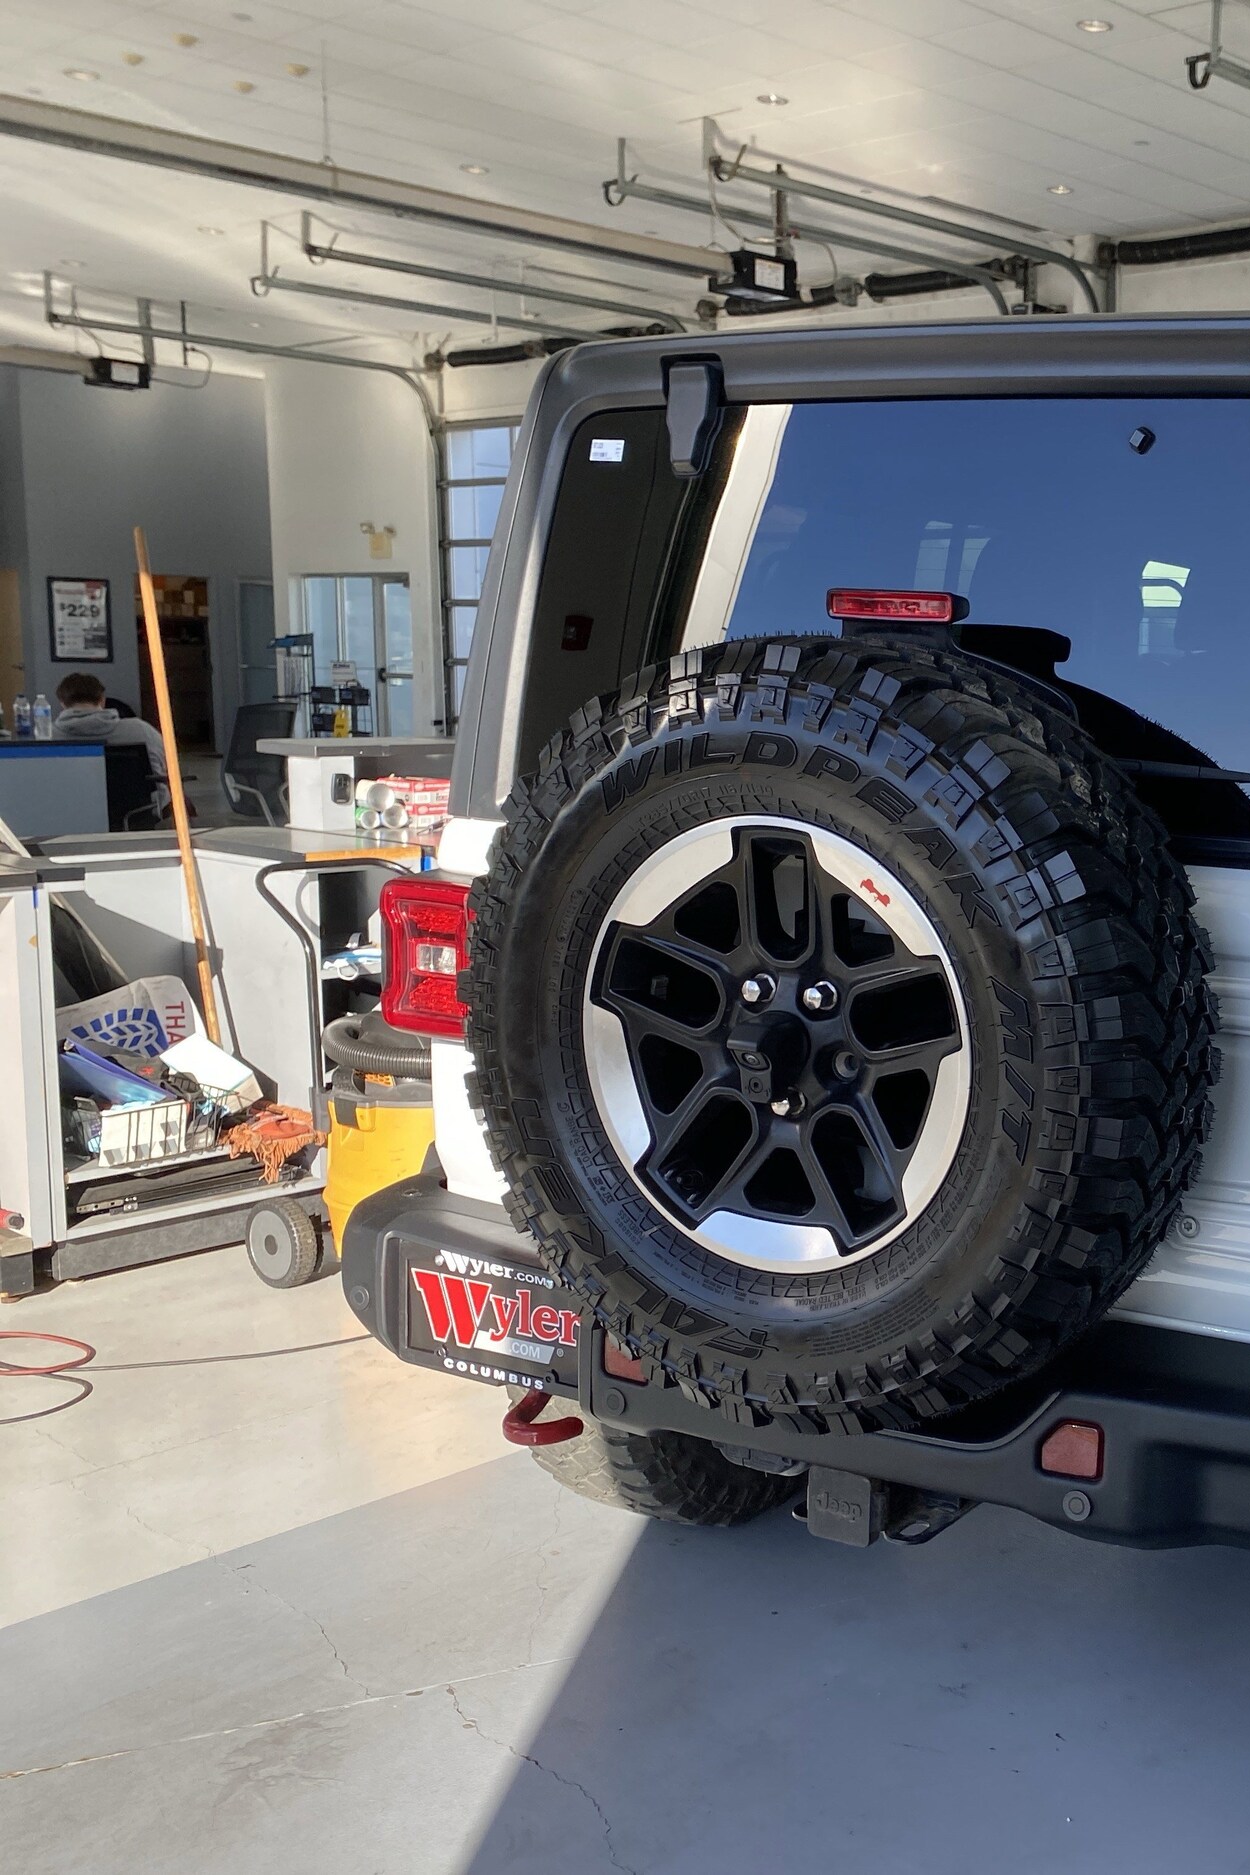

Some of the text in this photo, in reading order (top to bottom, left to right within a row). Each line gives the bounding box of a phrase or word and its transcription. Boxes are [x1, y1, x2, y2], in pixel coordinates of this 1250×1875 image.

[598, 730, 1035, 1167] WILDPEAK M/T
[564, 1114, 581, 1145] RANGE
[576, 1143, 593, 1169] LOAD
[795, 1296, 816, 1307] RADIAL
[845, 1282, 866, 1297] STEEL
[411, 1267, 581, 1349] Wyler
[443, 1358, 544, 1390] COLUMBUS
[816, 1490, 863, 1523] Jeep
